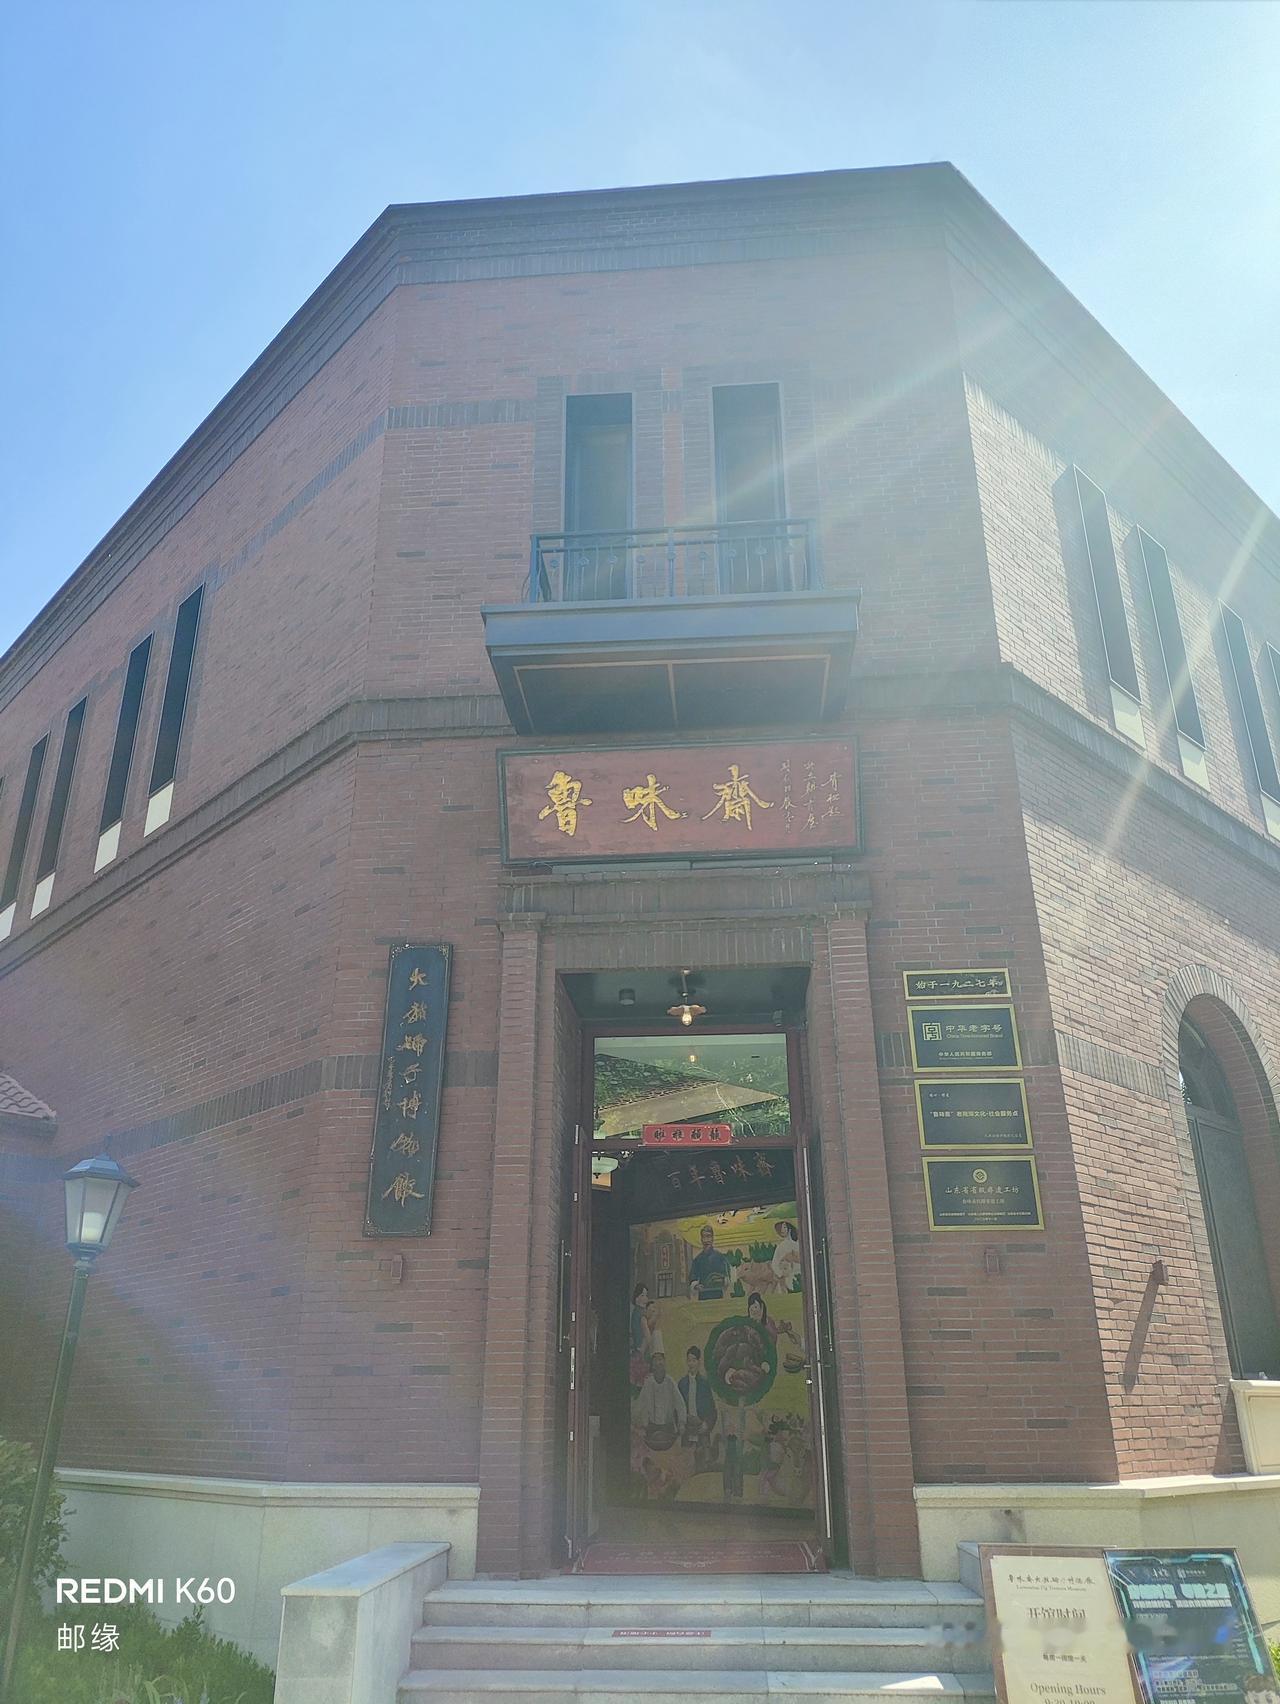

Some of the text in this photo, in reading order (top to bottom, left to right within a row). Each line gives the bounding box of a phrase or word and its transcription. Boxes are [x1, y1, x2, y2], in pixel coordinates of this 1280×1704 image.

[945, 1023, 1003, 1033] 中华老字号
[1030, 1682, 1106, 1696] Opening Hours
